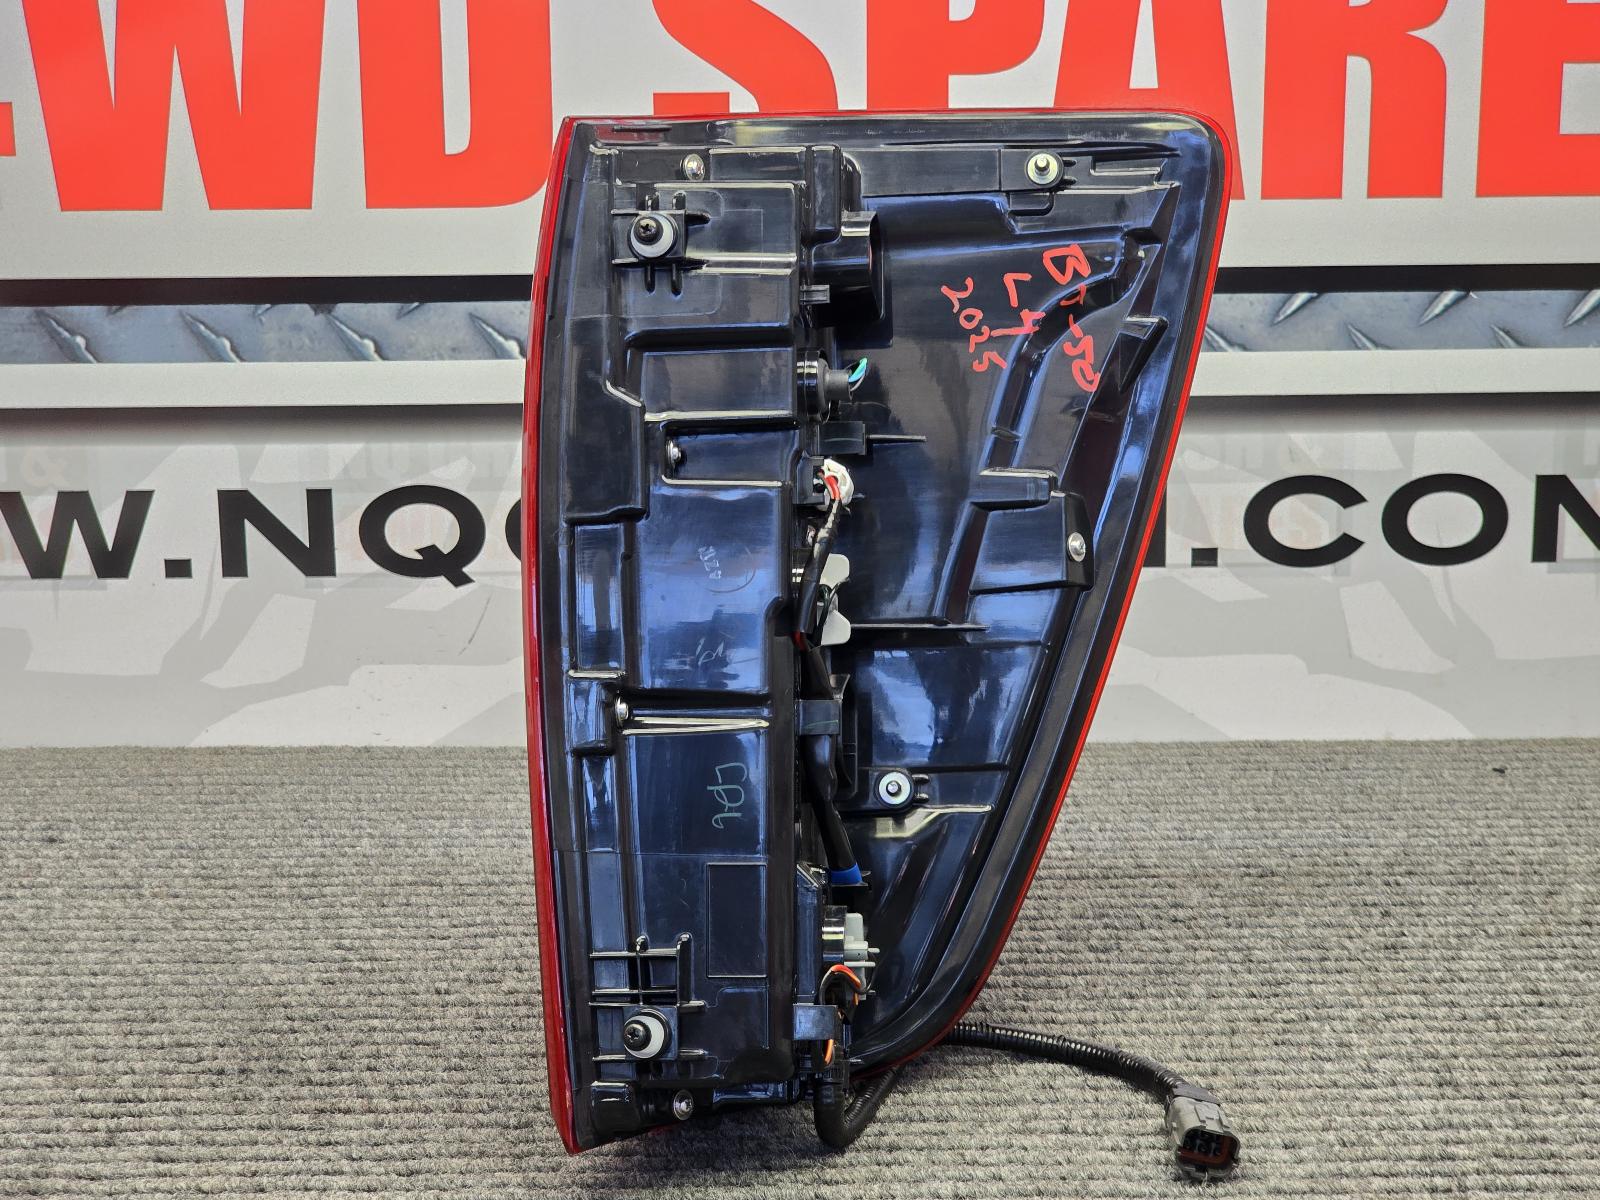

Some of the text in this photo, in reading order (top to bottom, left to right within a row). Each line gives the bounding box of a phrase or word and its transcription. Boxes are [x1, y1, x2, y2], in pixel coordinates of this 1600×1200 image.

[0, 0, 553, 212] WD
[940, 277, 1008, 373] 2025
[0, 484, 524, 588] W.NQ
